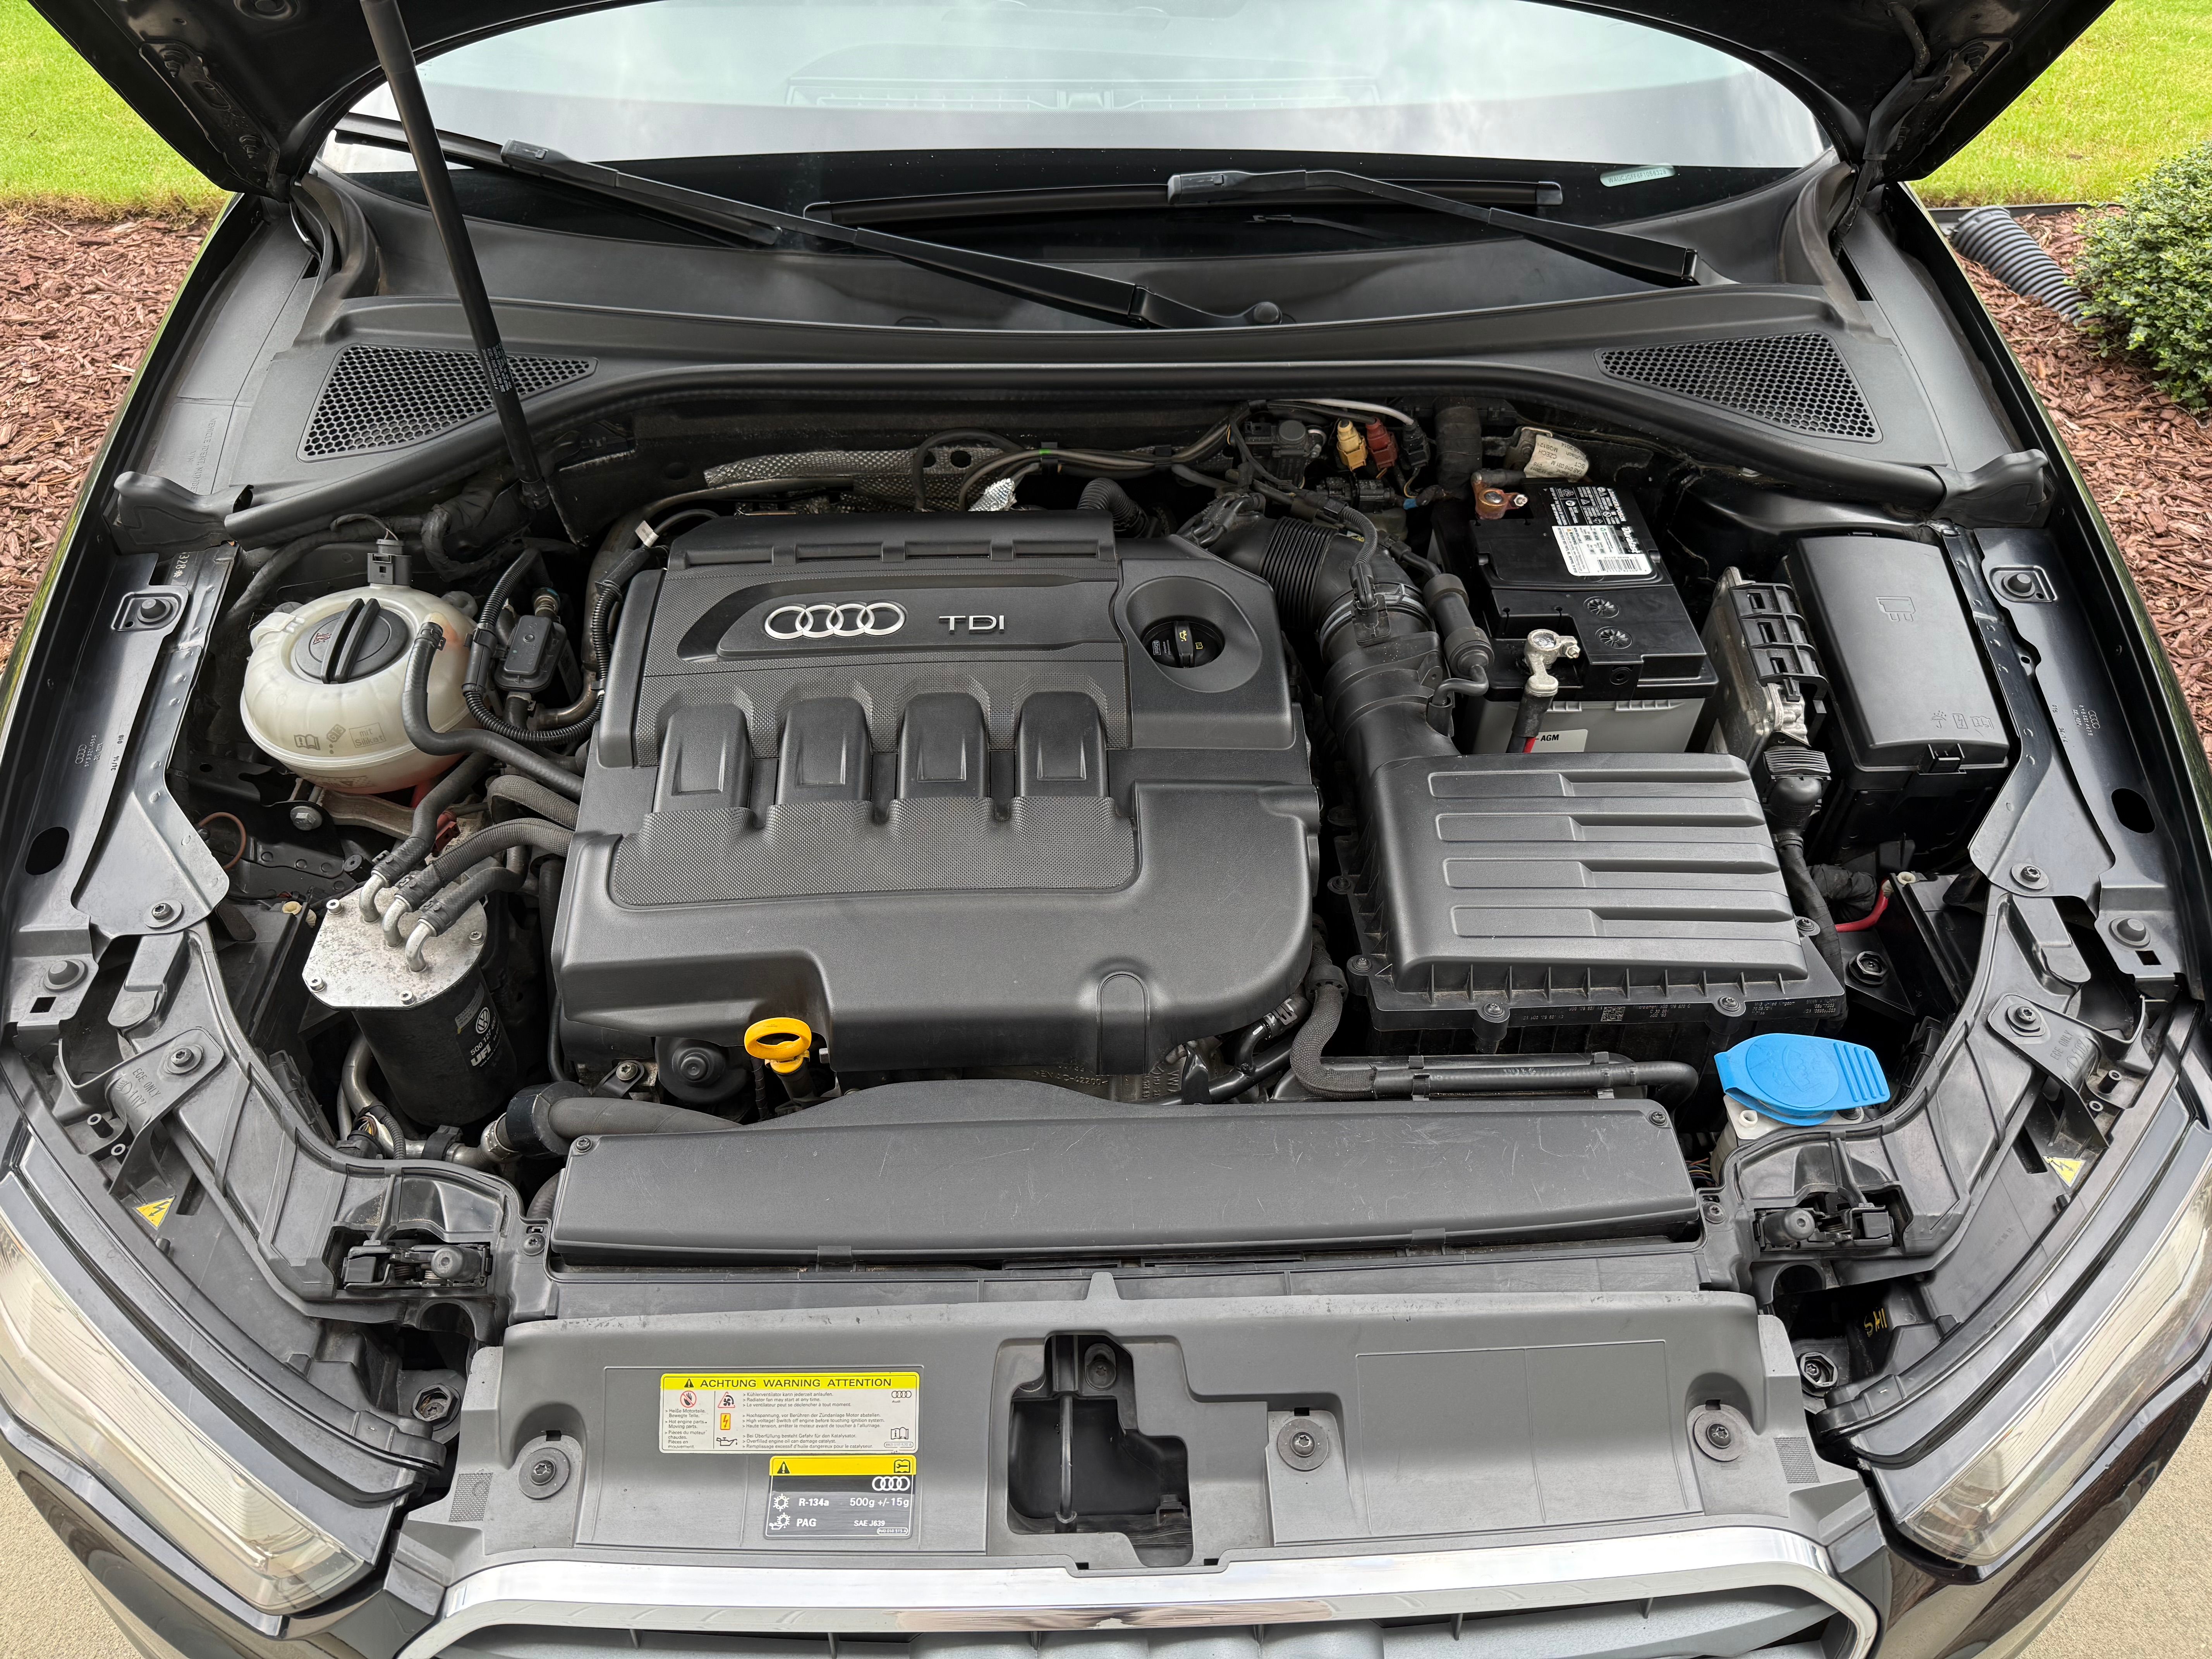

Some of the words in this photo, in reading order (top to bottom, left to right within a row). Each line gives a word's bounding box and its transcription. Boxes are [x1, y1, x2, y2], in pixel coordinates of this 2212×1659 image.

[1540, 443, 1558, 452] MQB12
[1539, 449, 1557, 459] CZECH
[1608, 491, 1626, 521] DANGER/POISON
[1620, 526, 1641, 553] Duralast
[939, 615, 1004, 632] TDI
[328, 726, 344, 740] G13
[359, 728, 373, 737] mit
[1540, 733, 1559, 741] AGM
[355, 735, 384, 746] Silikat
[471, 1042, 483, 1055] 5Q0
[2050, 1047, 2063, 1060] ECE
[2059, 1030, 2073, 1046] ONLY
[471, 1044, 491, 1066] UFI
[133, 1068, 147, 1082] ECE
[144, 1082, 161, 1097] ONLY
[764, 1379, 820, 1387] WARNING
[827, 1378, 891, 1387] ATTENTION
[799, 1498, 829, 1506] R-134a
[850, 1498, 875, 1508] 500g
[891, 1498, 909, 1507] 15g
[797, 1518, 817, 1527] PAG
